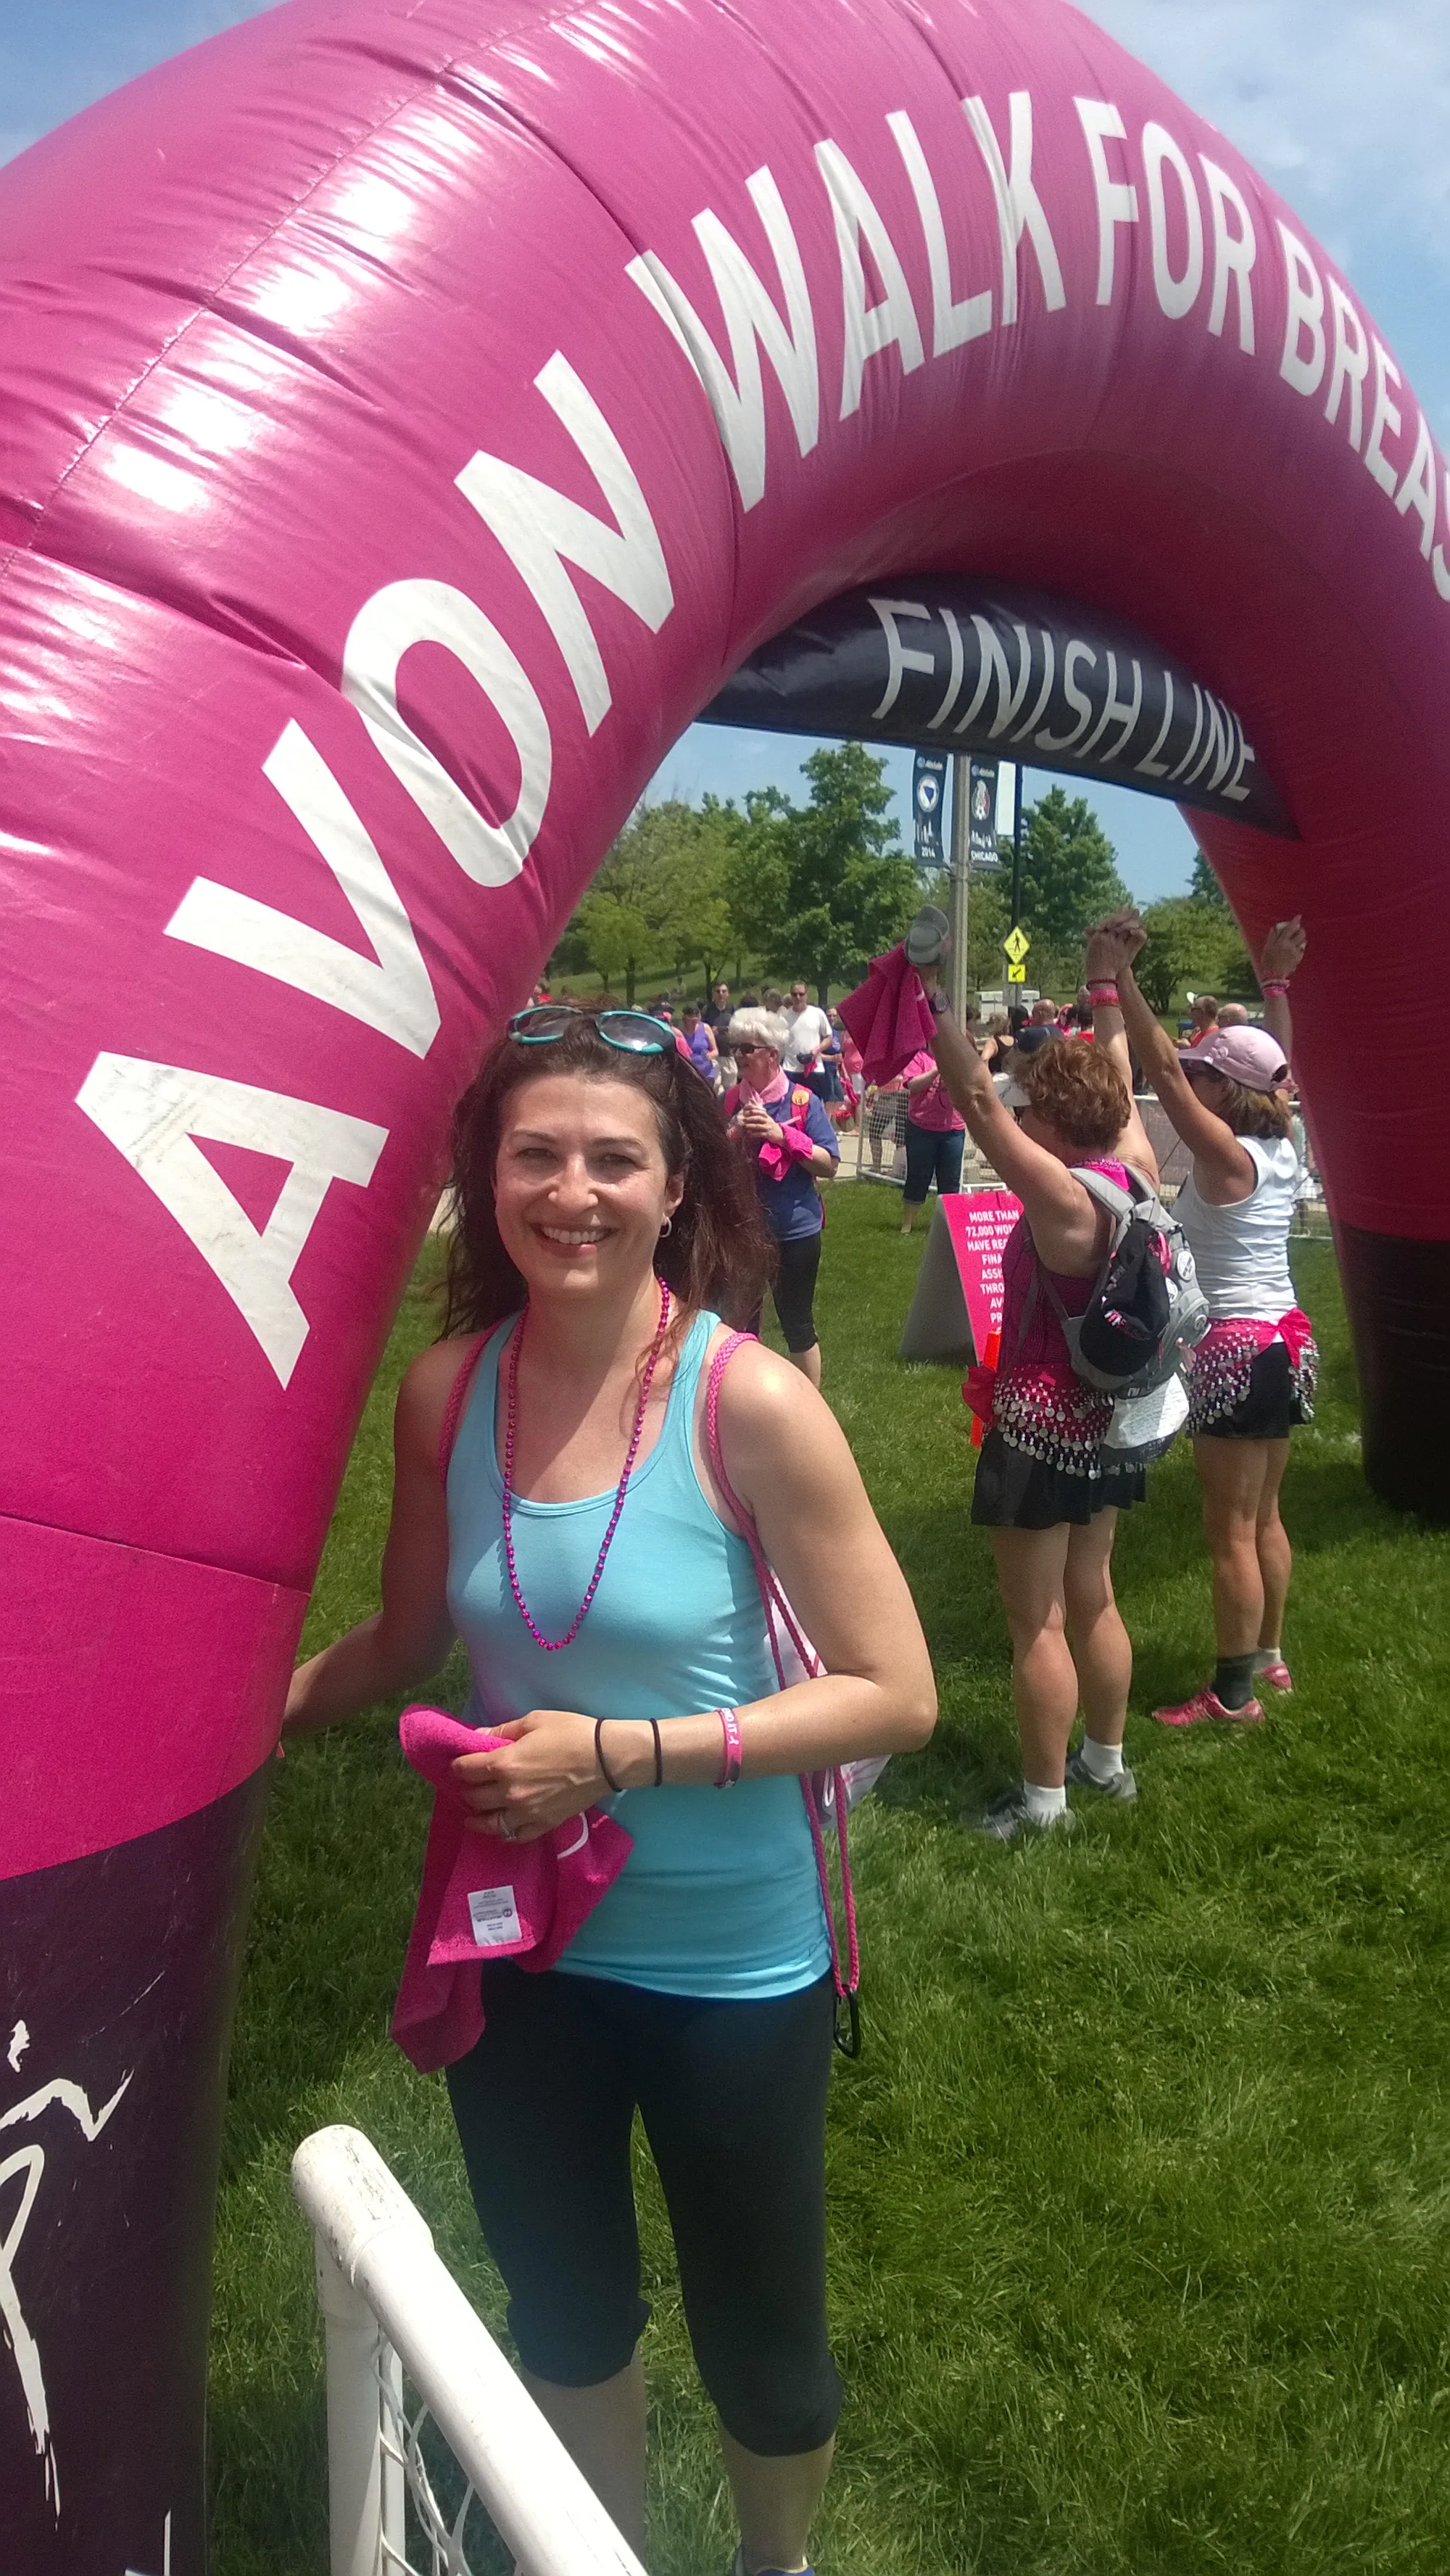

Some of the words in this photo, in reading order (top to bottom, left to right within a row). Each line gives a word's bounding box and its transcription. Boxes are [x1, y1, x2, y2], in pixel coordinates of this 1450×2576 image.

[868, 598, 1143, 763] FINISH
[1134, 671, 1255, 801] LINE
[75, 349, 674, 1391] AVON
[625, 91, 1066, 513] WALK
[1073, 96, 1256, 356] FOR
[969, 1210, 995, 1223] MORE
[995, 1210, 1019, 1221] THAN
[965, 1225, 994, 1238] 72,000
[966, 1239, 991, 1252] HAVE
[981, 1268, 1003, 1281] ASSI
[990, 1297, 1004, 1309] AV
